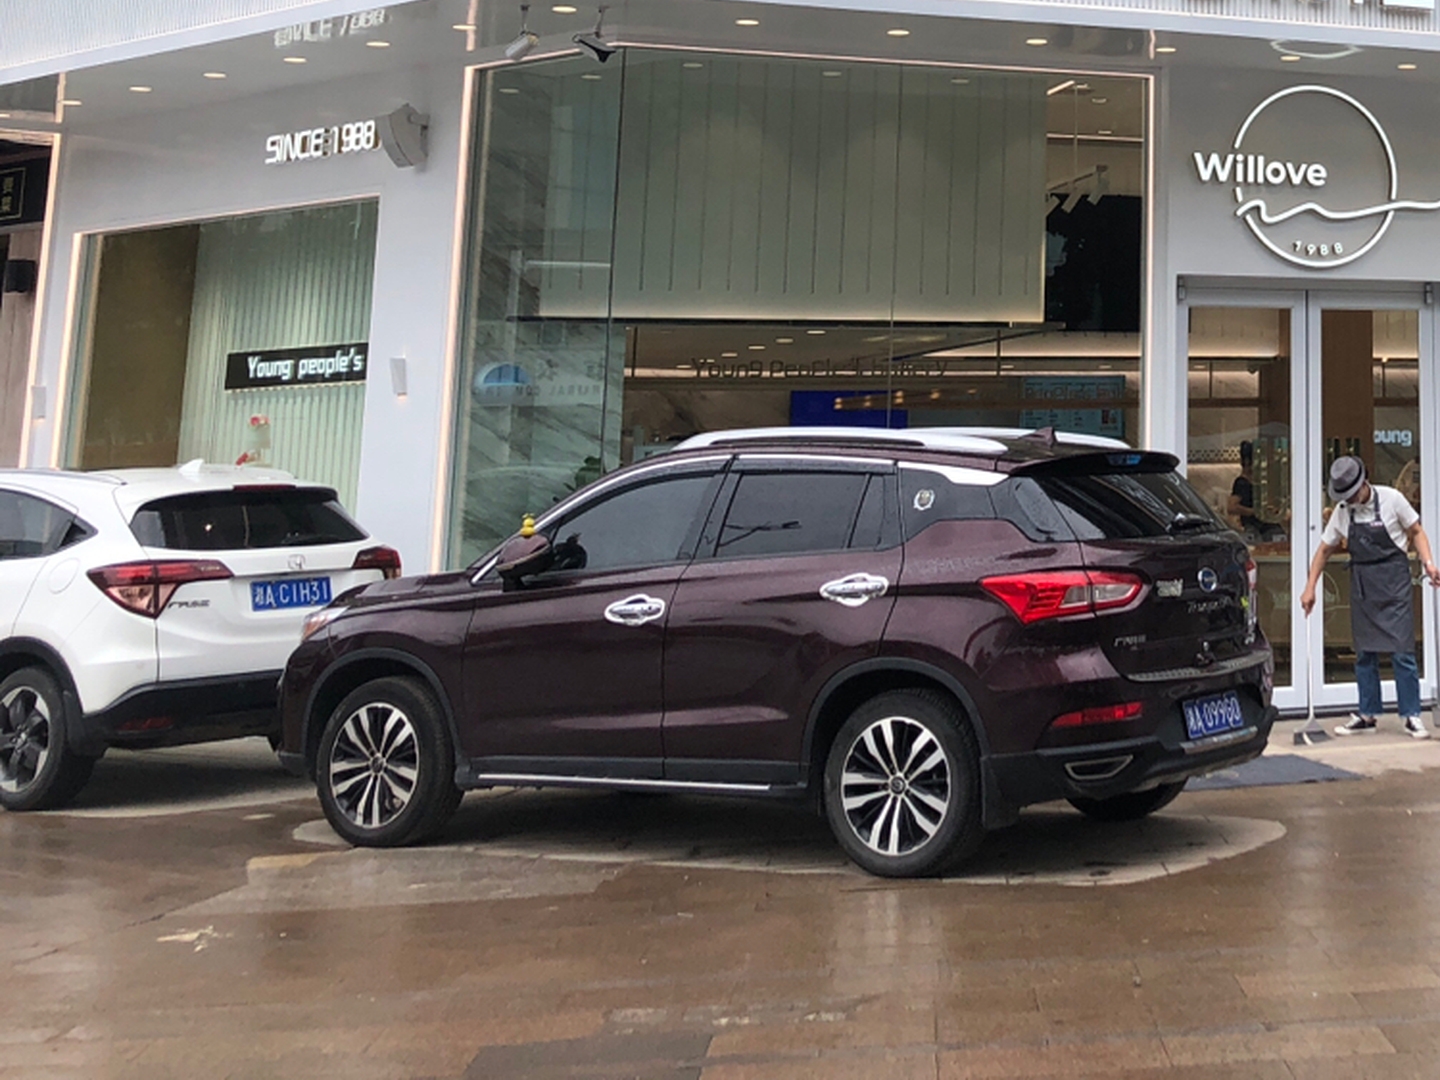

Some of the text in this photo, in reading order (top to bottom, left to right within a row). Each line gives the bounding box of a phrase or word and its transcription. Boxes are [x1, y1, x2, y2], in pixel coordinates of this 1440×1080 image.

[265, 119, 376, 164] SINCE 1988
[1192, 151, 1328, 188] Willove
[1292, 239, 1344, 257] 1988
[247, 347, 365, 380] Young people's
[1373, 429, 1412, 447] oung
